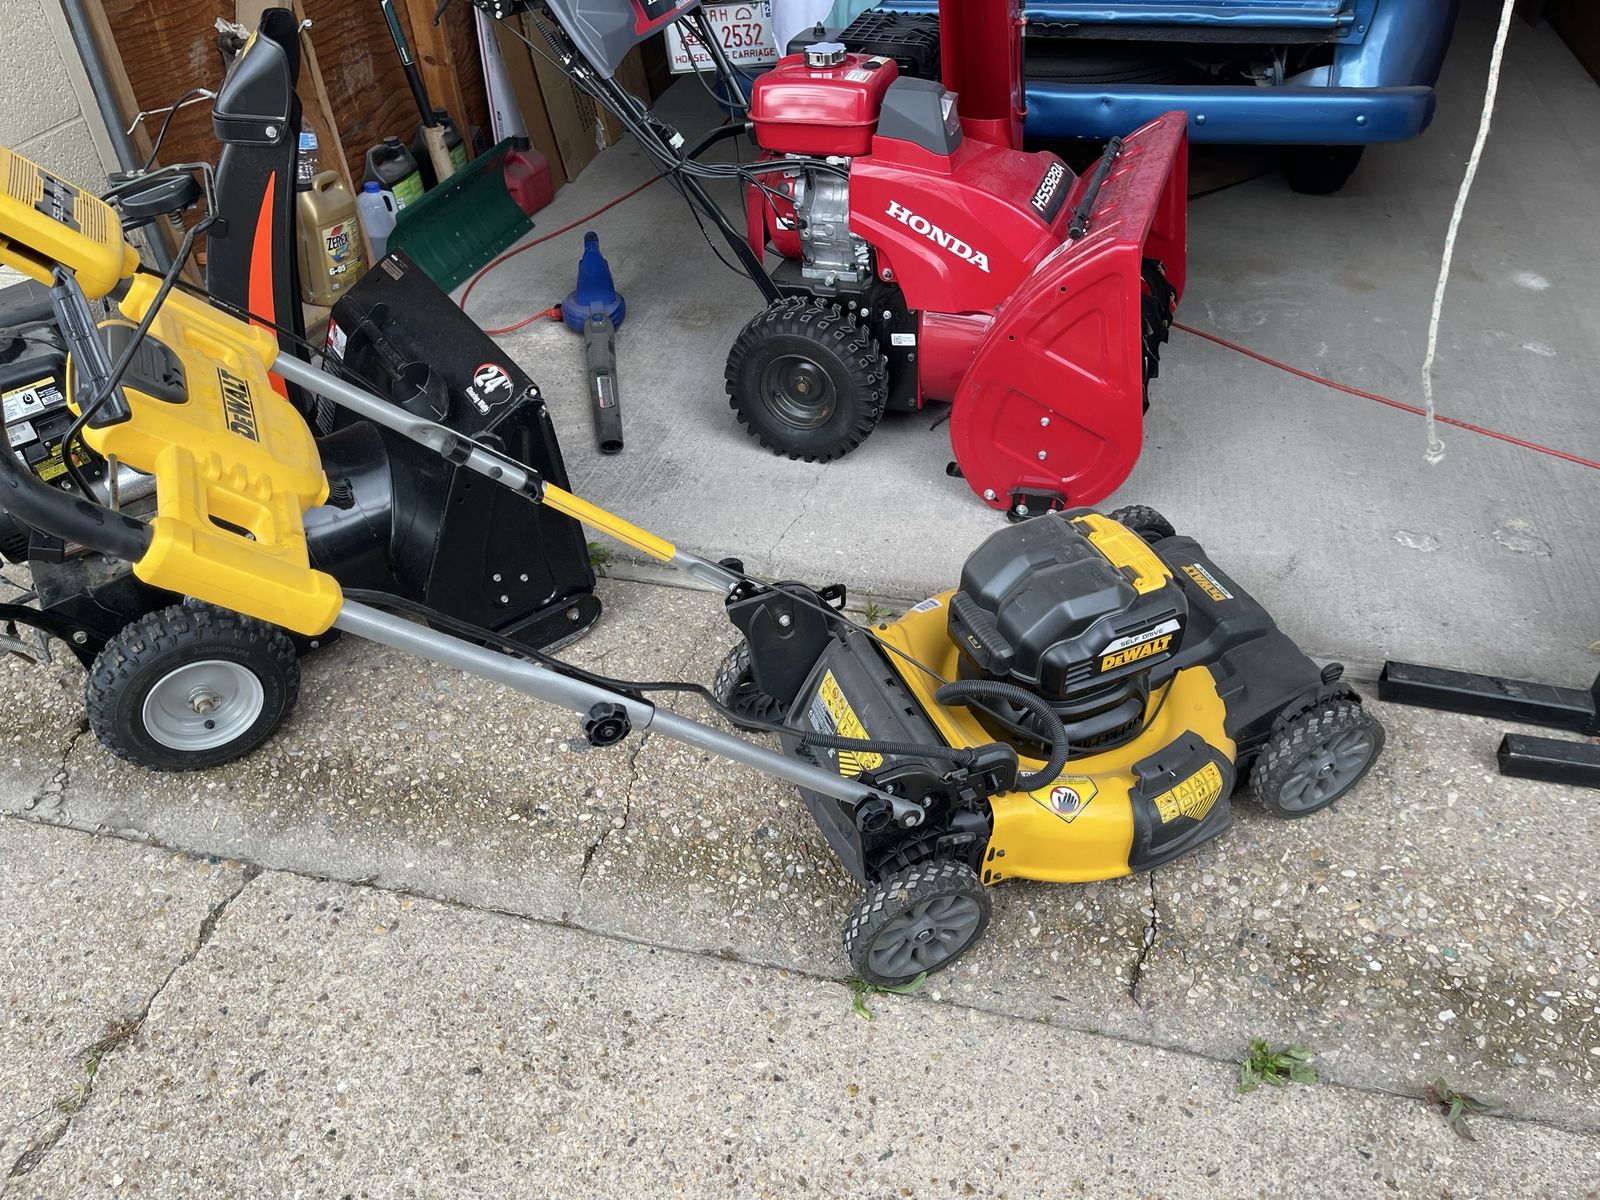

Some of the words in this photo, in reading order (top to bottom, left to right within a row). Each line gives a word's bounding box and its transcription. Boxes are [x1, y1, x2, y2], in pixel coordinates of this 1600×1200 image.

[721, 23, 764, 49] 2532
[732, 47, 776, 60] CARRIAGE
[1031, 162, 1065, 211] HSS928A
[326, 231, 350, 251] ZEREX
[885, 199, 990, 274] HONDA
[1120, 636, 1140, 648] SELF
[1142, 627, 1164, 640] DRIVE
[1101, 634, 1173, 673] DEWALT
